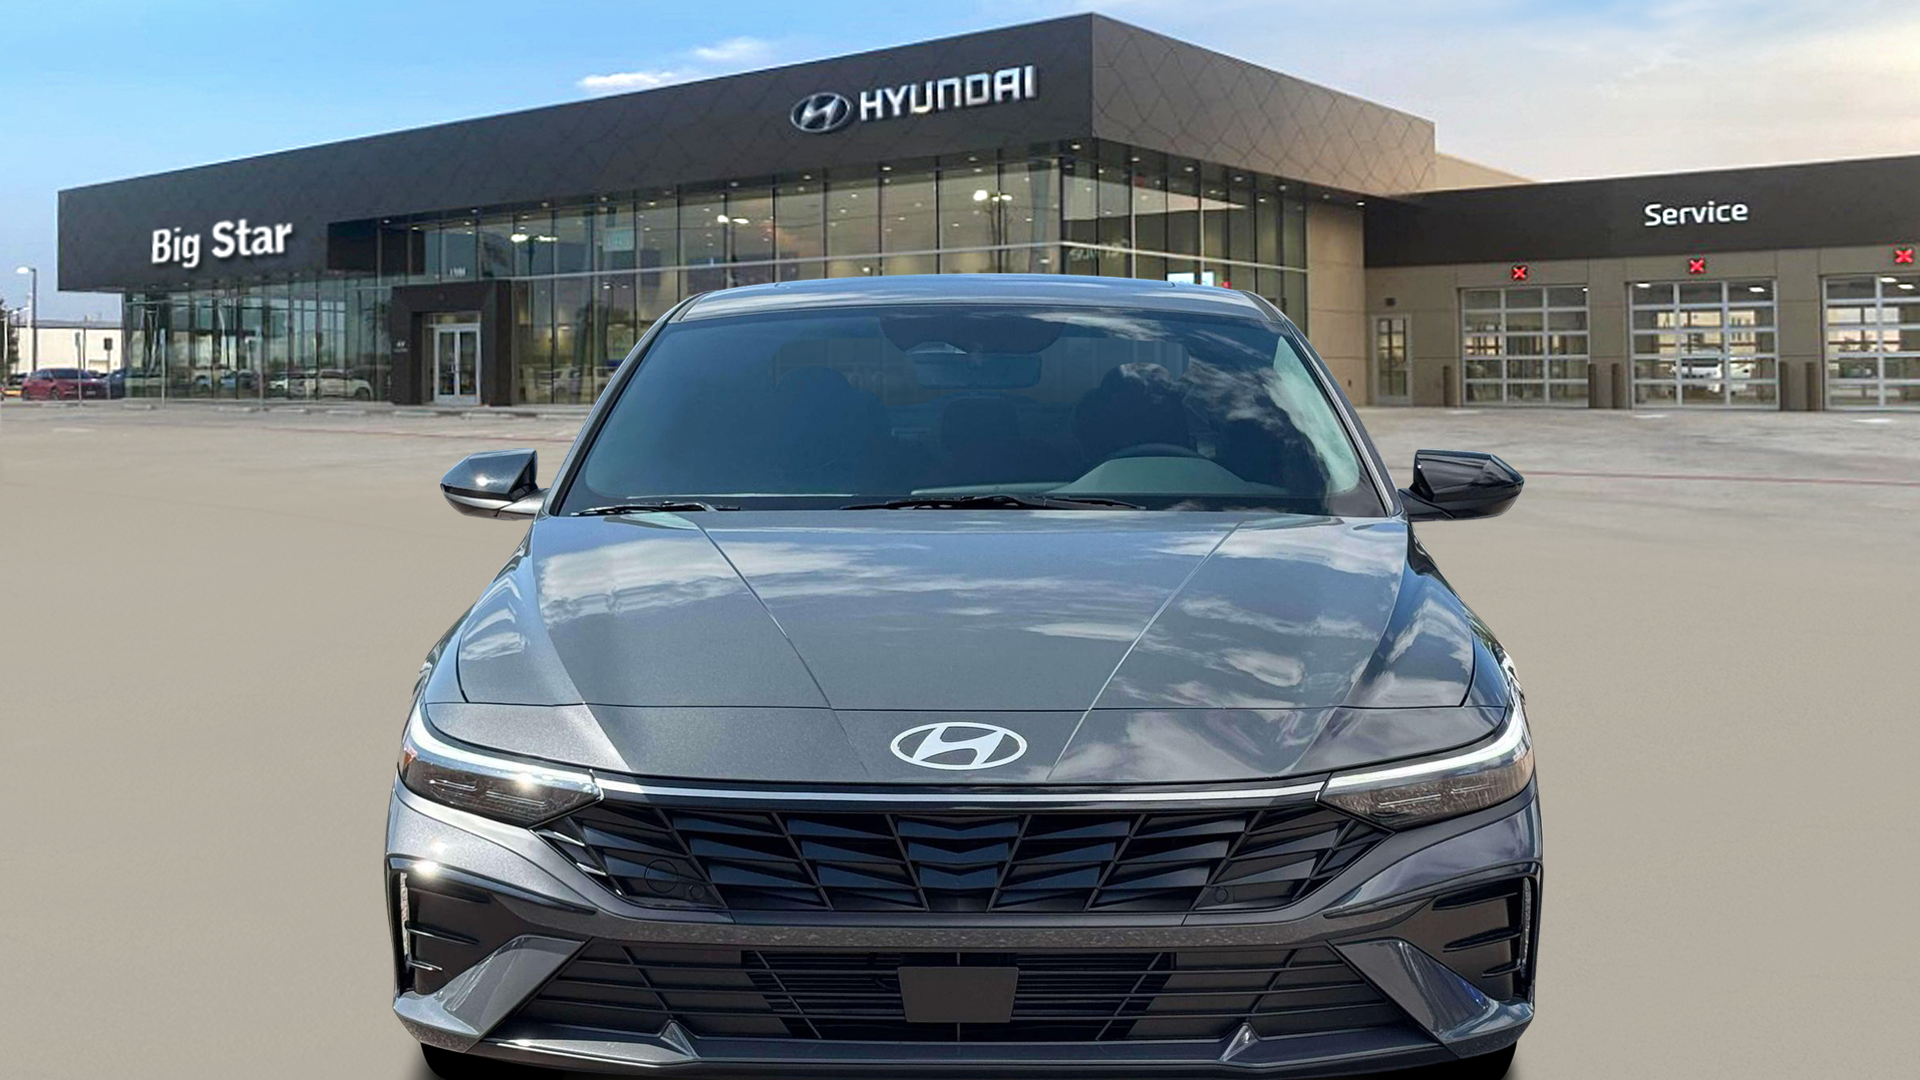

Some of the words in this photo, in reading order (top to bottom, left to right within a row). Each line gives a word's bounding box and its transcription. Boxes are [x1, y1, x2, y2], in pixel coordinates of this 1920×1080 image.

[859, 65, 1036, 122] HYUNDAI
[1644, 200, 1748, 227] Service
[152, 227, 201, 268] Big
[211, 218, 293, 259] Star
